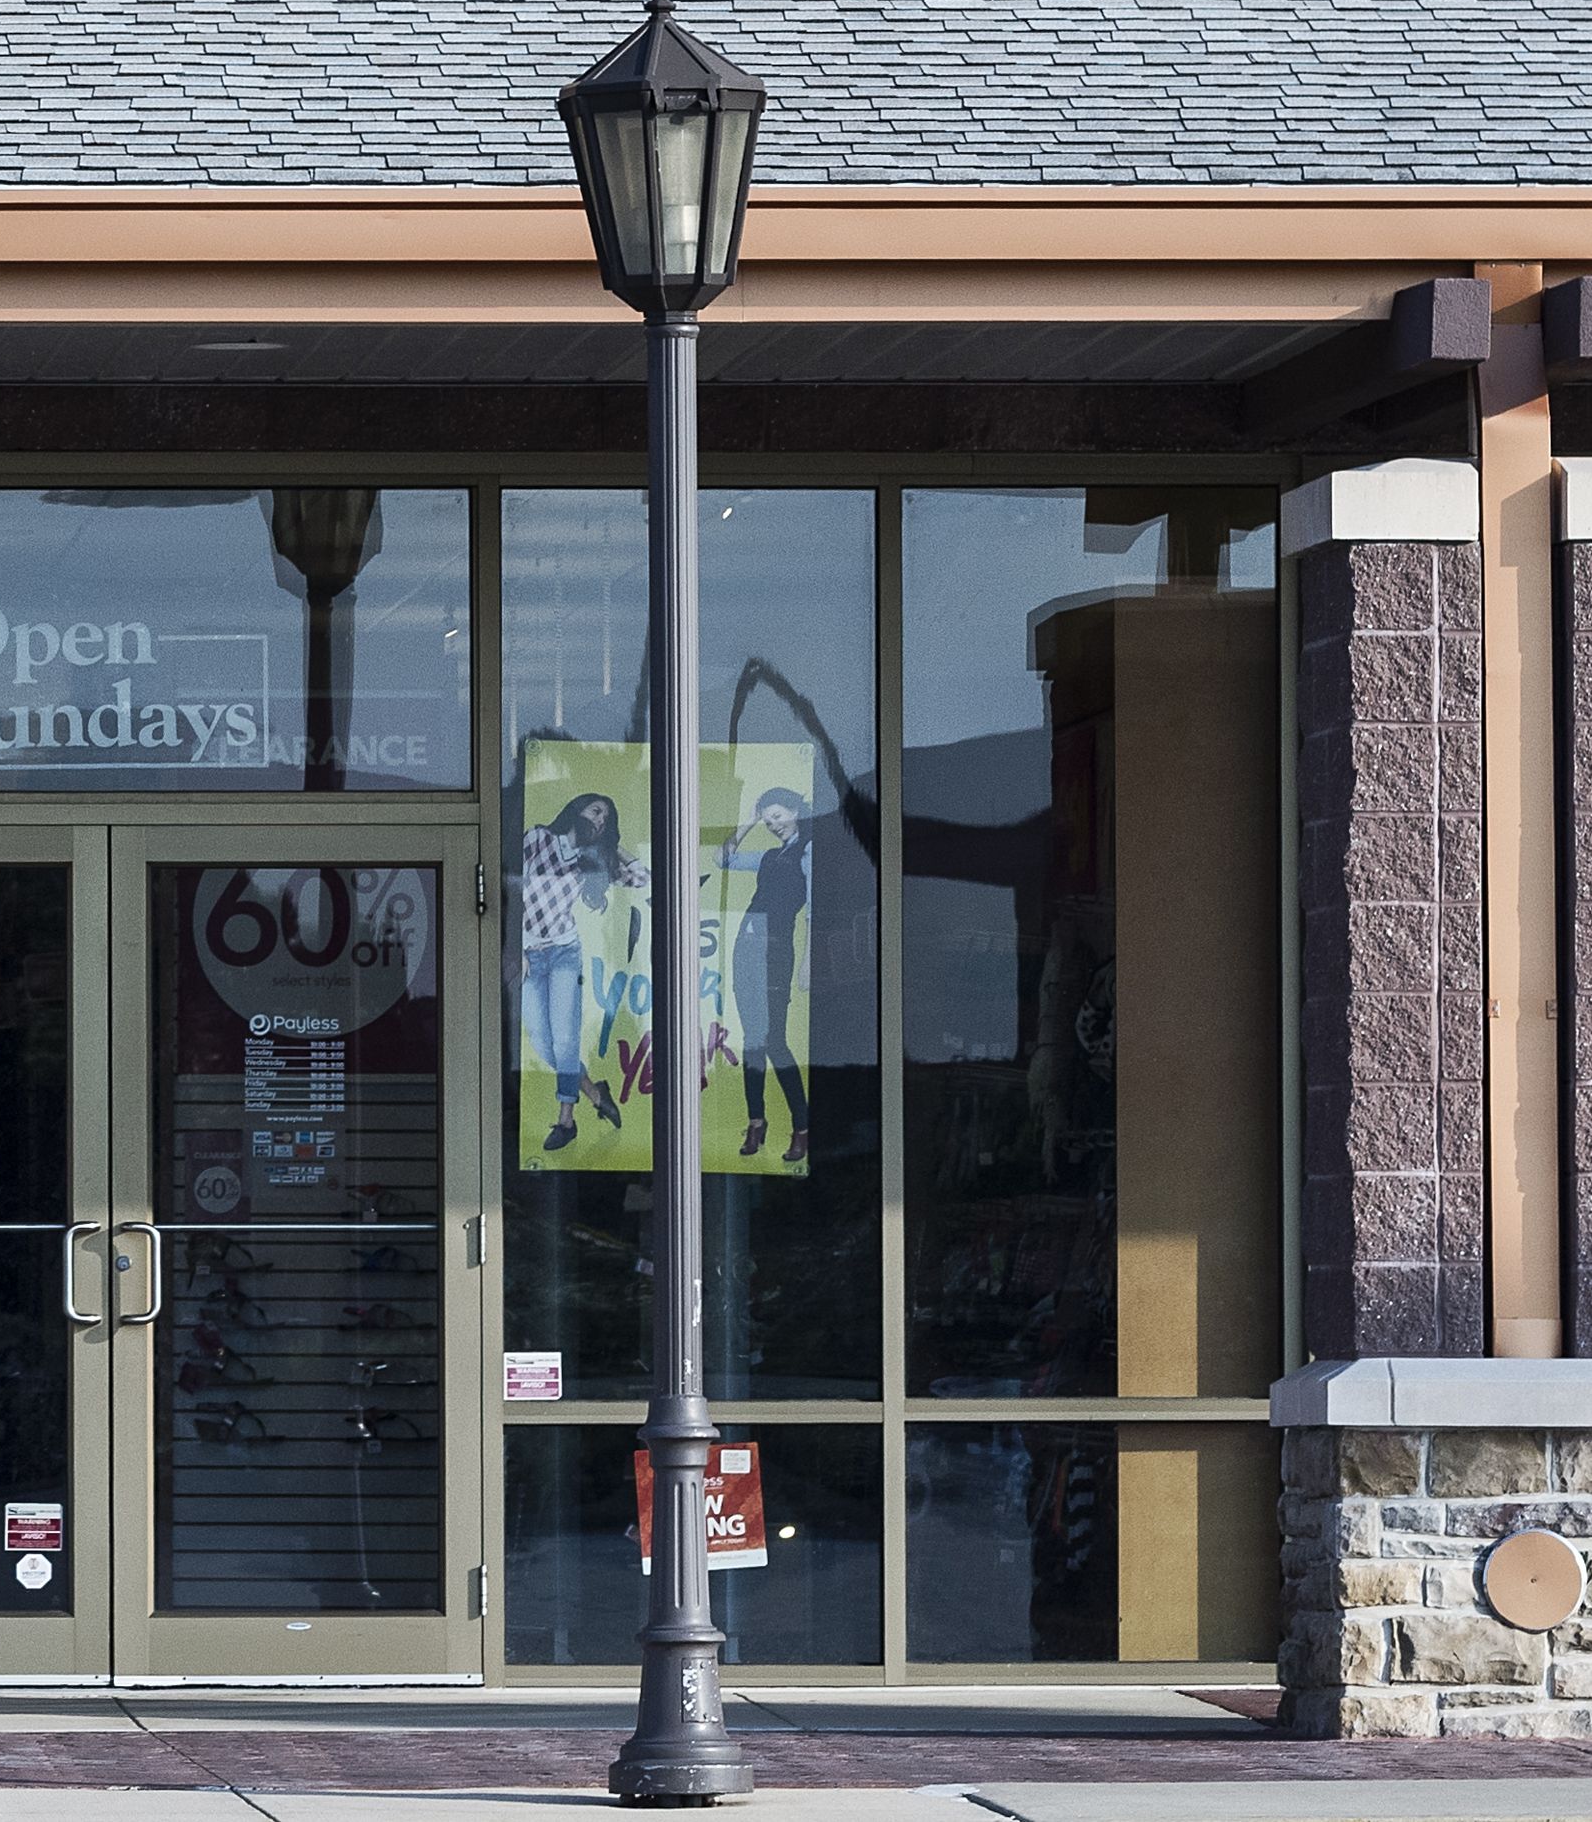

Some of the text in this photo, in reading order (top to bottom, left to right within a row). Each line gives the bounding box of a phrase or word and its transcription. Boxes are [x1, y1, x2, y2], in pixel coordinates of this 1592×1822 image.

[592, 956, 722, 1058] YOR
[273, 1016, 340, 1033] Payless
[245, 1038, 274, 1047] Monday
[245, 1048, 274, 1057] Tuesday
[245, 1059, 286, 1068] Wednesday
[617, 1021, 739, 1104] YR
[245, 1069, 277, 1078] Thursday
[245, 1079, 267, 1089] Friday
[245, 1090, 276, 1099] Saturday
[245, 1100, 271, 1110] Sunday
